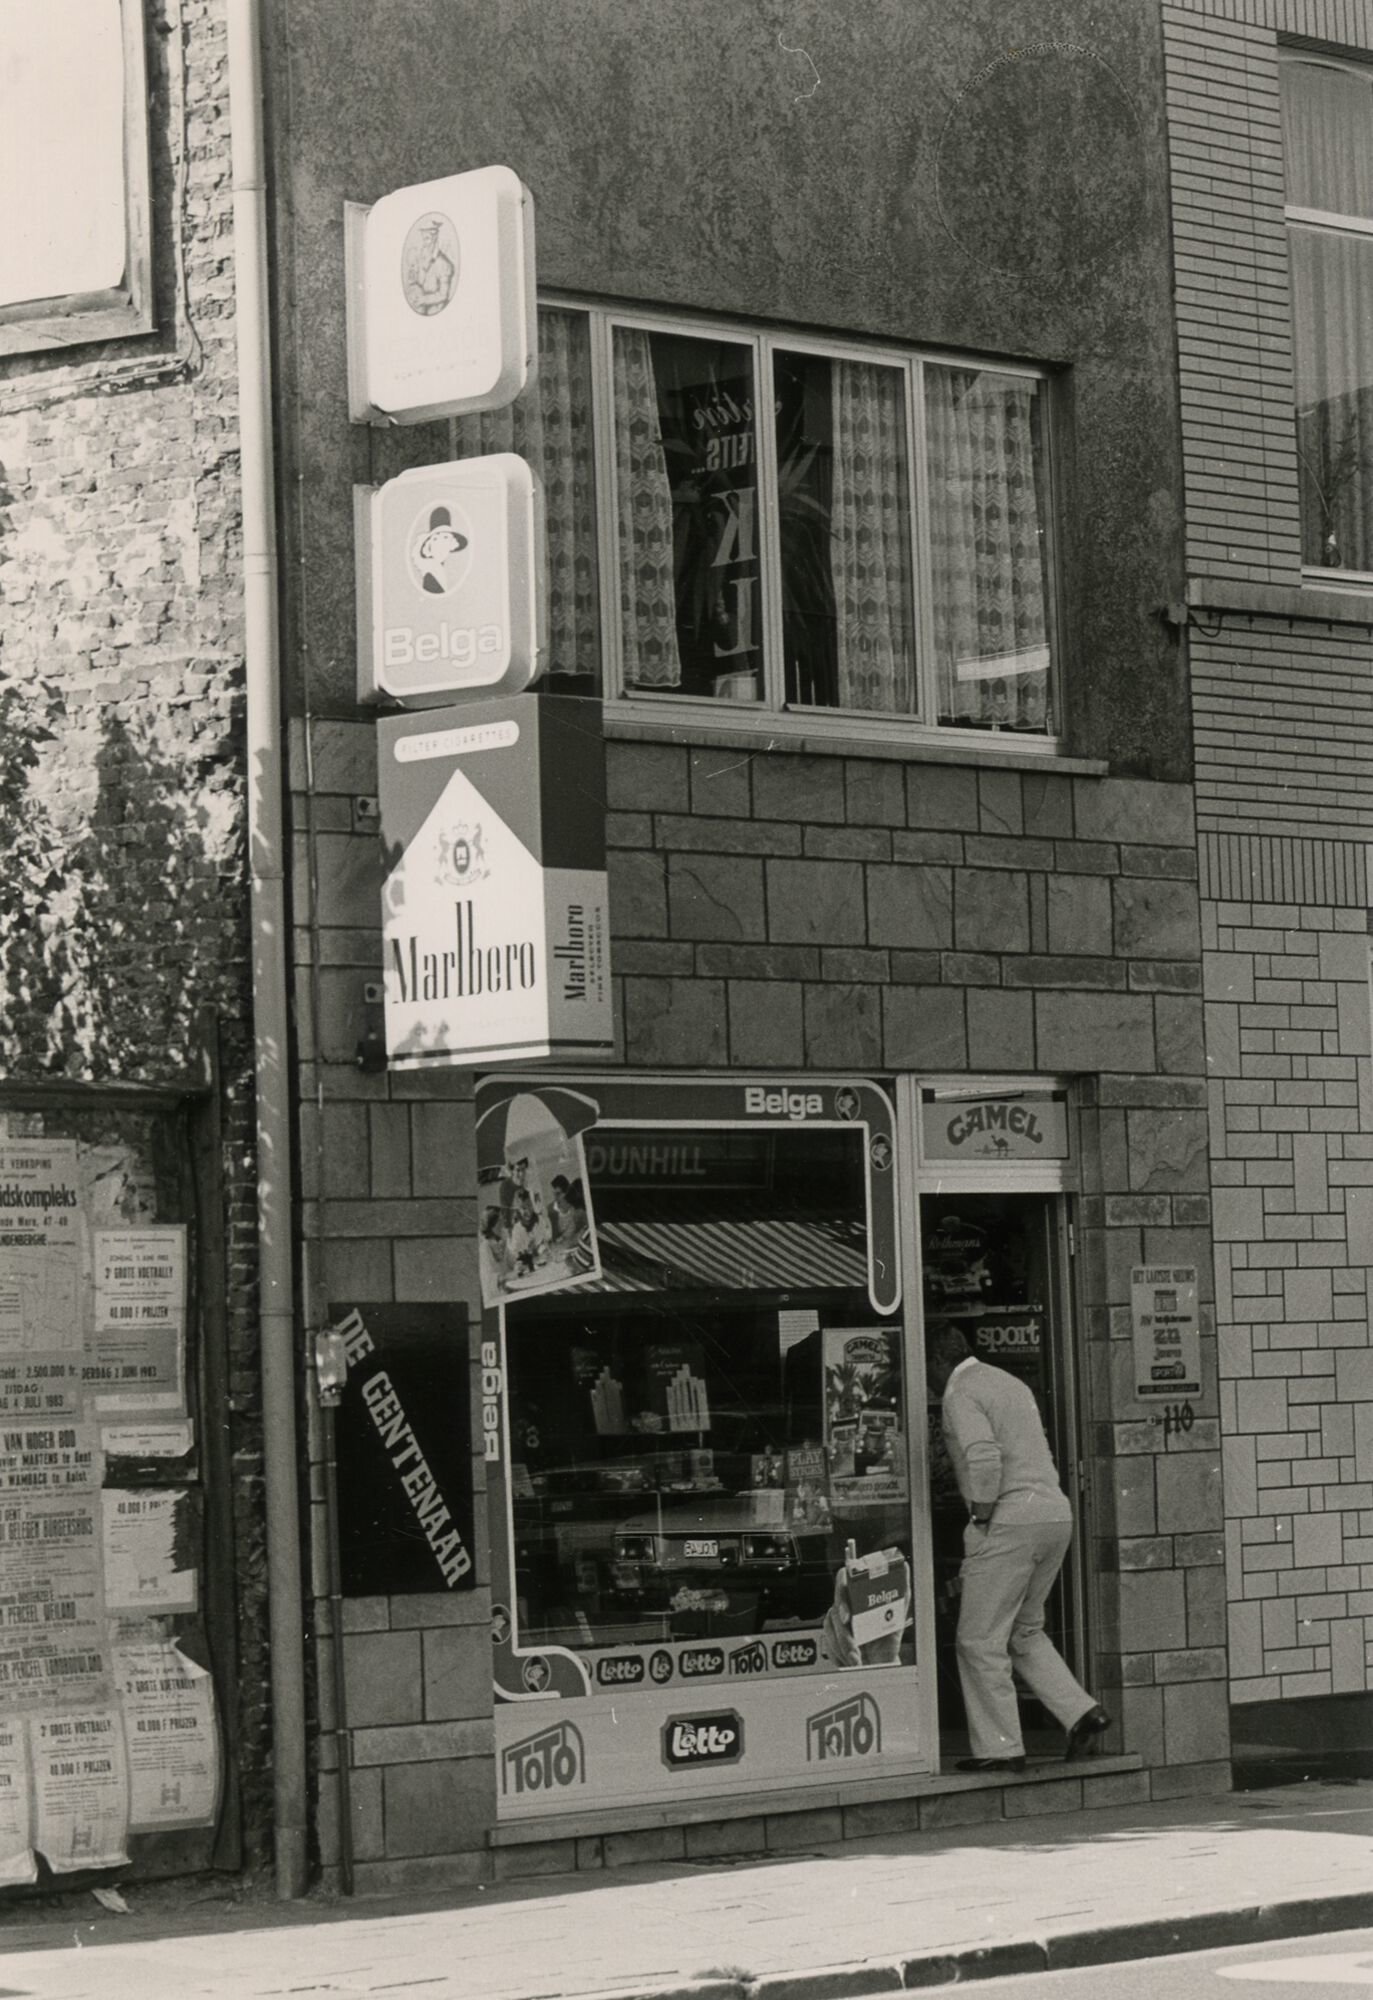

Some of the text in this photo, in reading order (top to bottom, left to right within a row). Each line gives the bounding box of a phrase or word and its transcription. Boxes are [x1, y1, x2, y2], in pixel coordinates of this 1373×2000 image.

[384, 621, 503, 668] Belga
[390, 899, 535, 1004] Marlboro
[553, 904, 587, 1003] Marlboro
[743, 1087, 823, 1120] Belga
[947, 1105, 1043, 1146] CAMEL
[588, 1145, 706, 1175] DUNHILL
[0, 1184, 77, 1211] idskompleks
[335, 1307, 375, 1367] DE
[846, 1339, 881, 1354] CAMEL
[976, 1318, 1040, 1352] sport
[481, 1341, 502, 1461] Belga
[4, 1429, 76, 1451] VAN HOGER BOD
[22, 1453, 58, 1466] MARTENS
[361, 1370, 472, 1588] GENTENAAR
[868, 1589, 899, 1607] Belga
[682, 1652, 721, 1673] Lotto
[775, 1641, 814, 1664] Lotto
[600, 1659, 641, 1681] Lotto
[672, 1725, 736, 1757] Lotto
